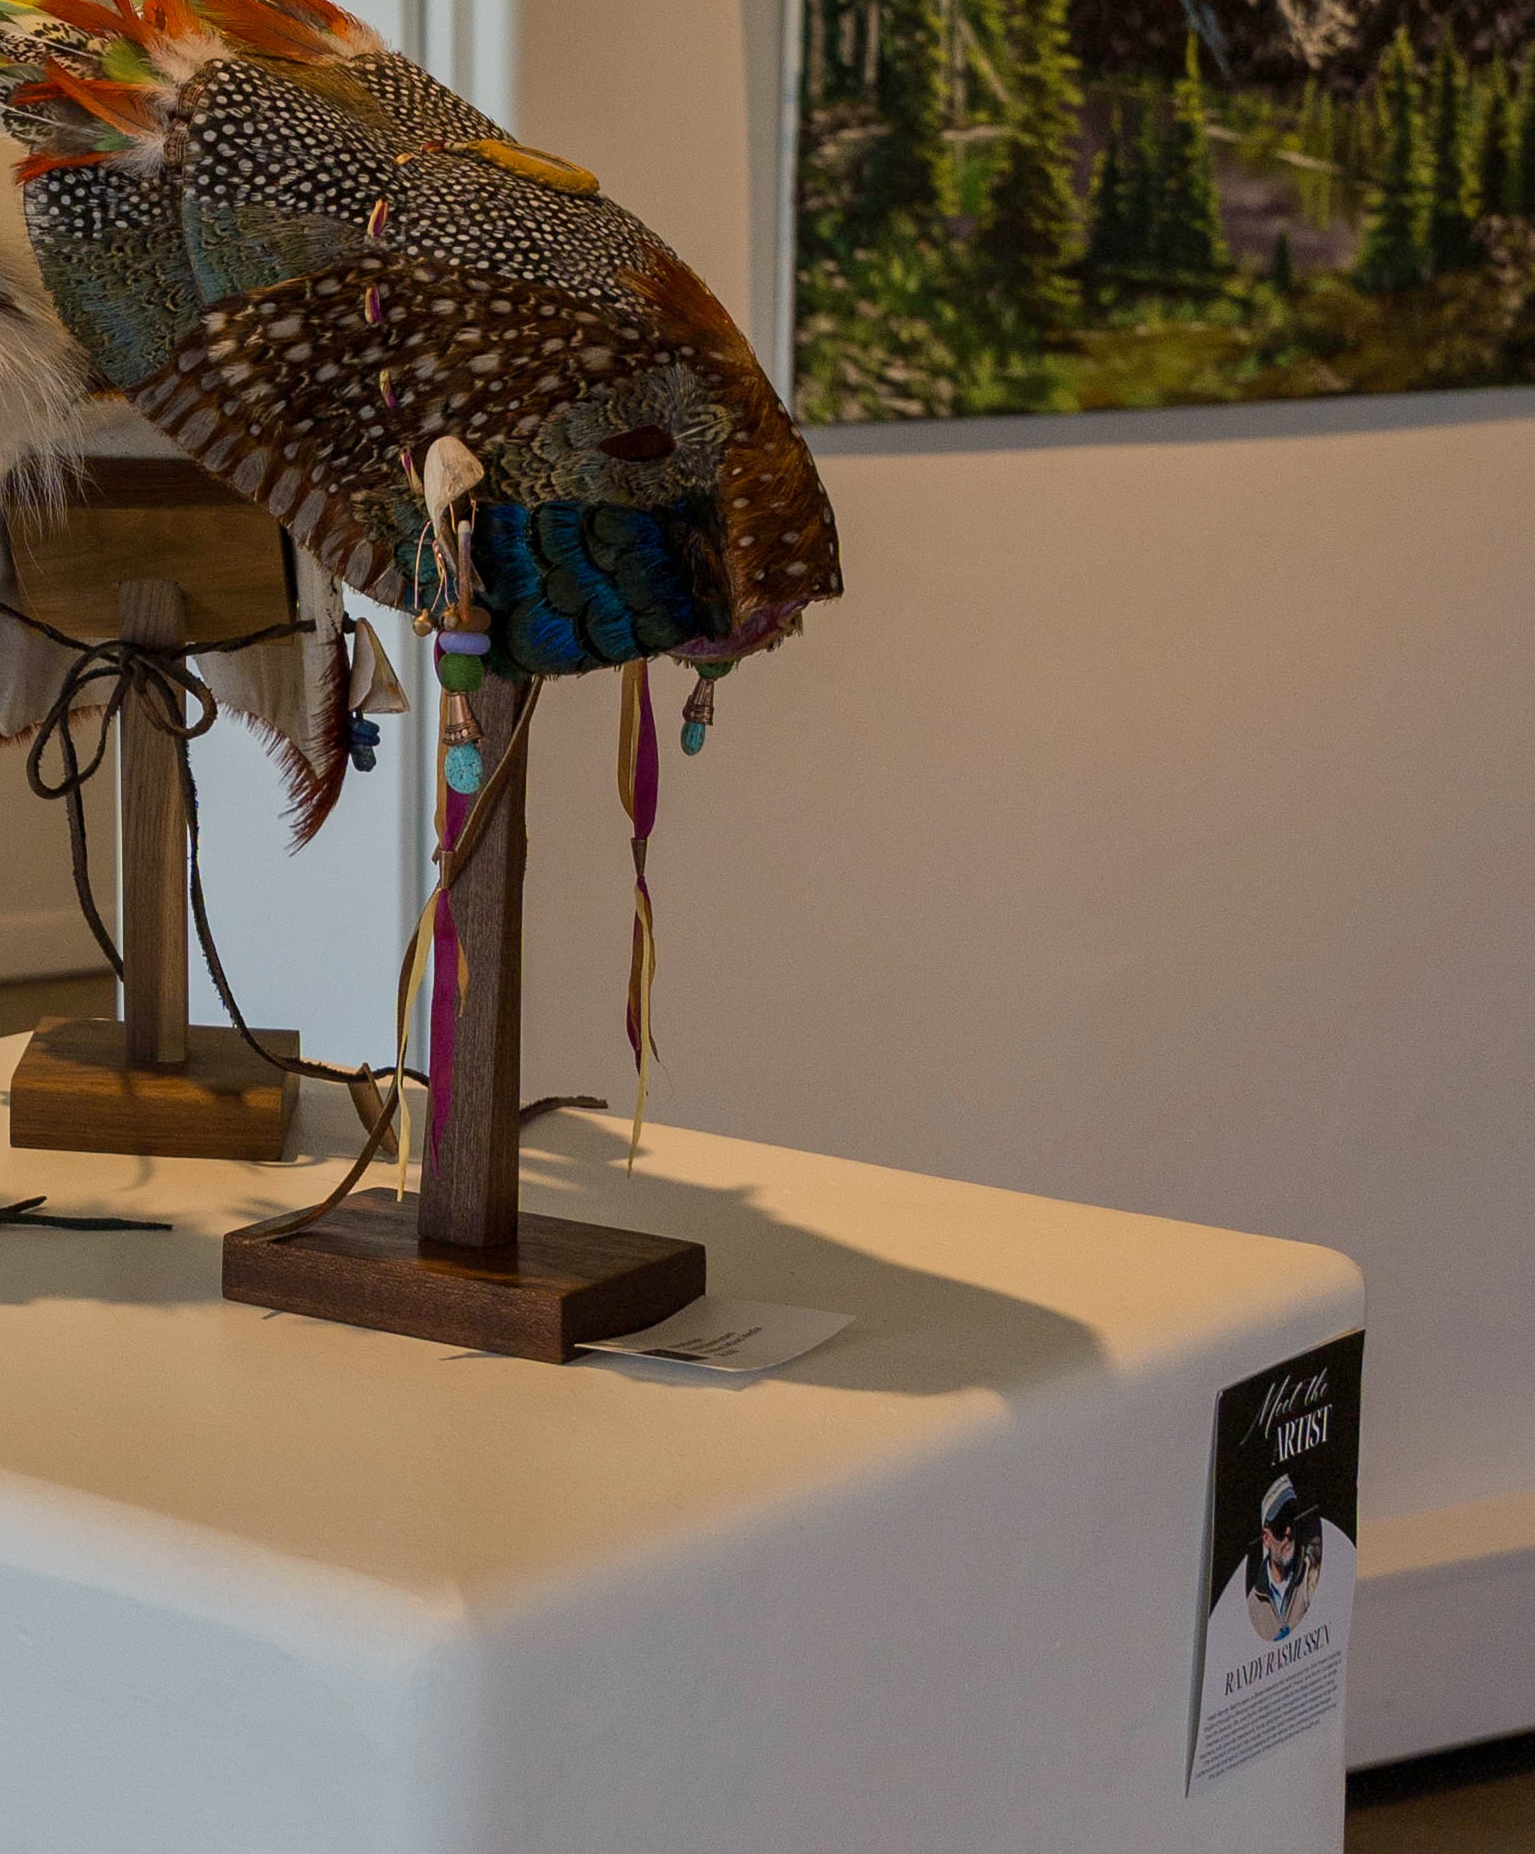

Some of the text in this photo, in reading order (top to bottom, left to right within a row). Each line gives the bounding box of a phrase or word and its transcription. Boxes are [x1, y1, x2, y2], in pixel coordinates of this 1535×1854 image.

[1239, 1367, 1328, 1445] Meet the
[1271, 1404, 1332, 1466] ARTIST
[1224, 1621, 1333, 1696] RANDY RASMUSSEN
